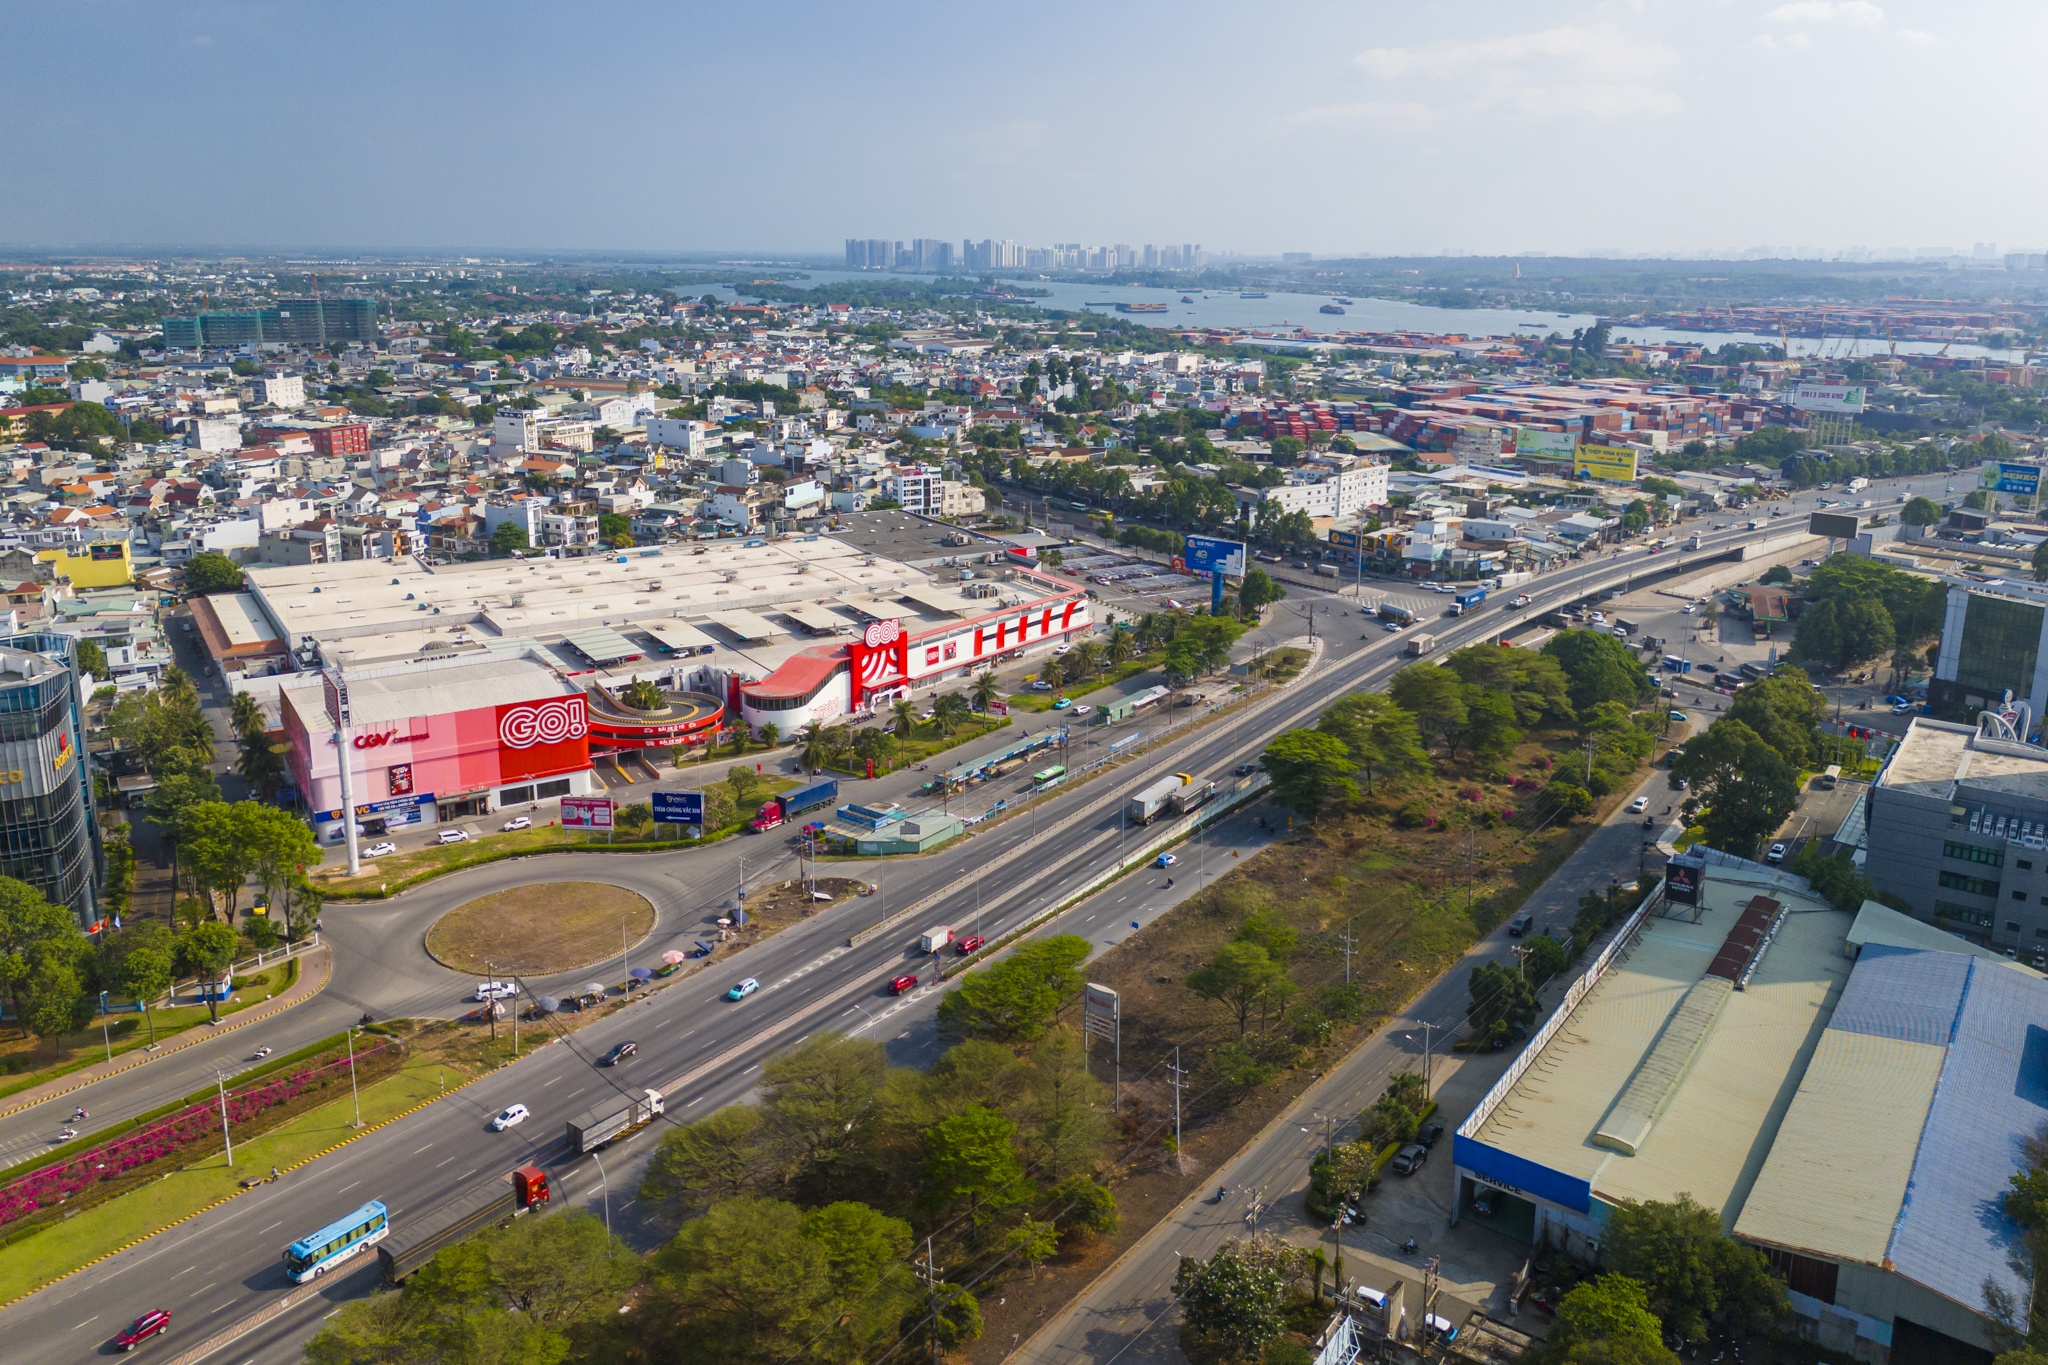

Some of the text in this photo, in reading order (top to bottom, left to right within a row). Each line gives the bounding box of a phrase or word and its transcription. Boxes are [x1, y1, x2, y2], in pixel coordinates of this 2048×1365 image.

[2003, 472, 2038, 481] SENKO
[865, 618, 899, 648] GO!
[500, 698, 588, 750] GO!
[353, 731, 391, 749] CGV
[1474, 1171, 1522, 1195] SERVICE
